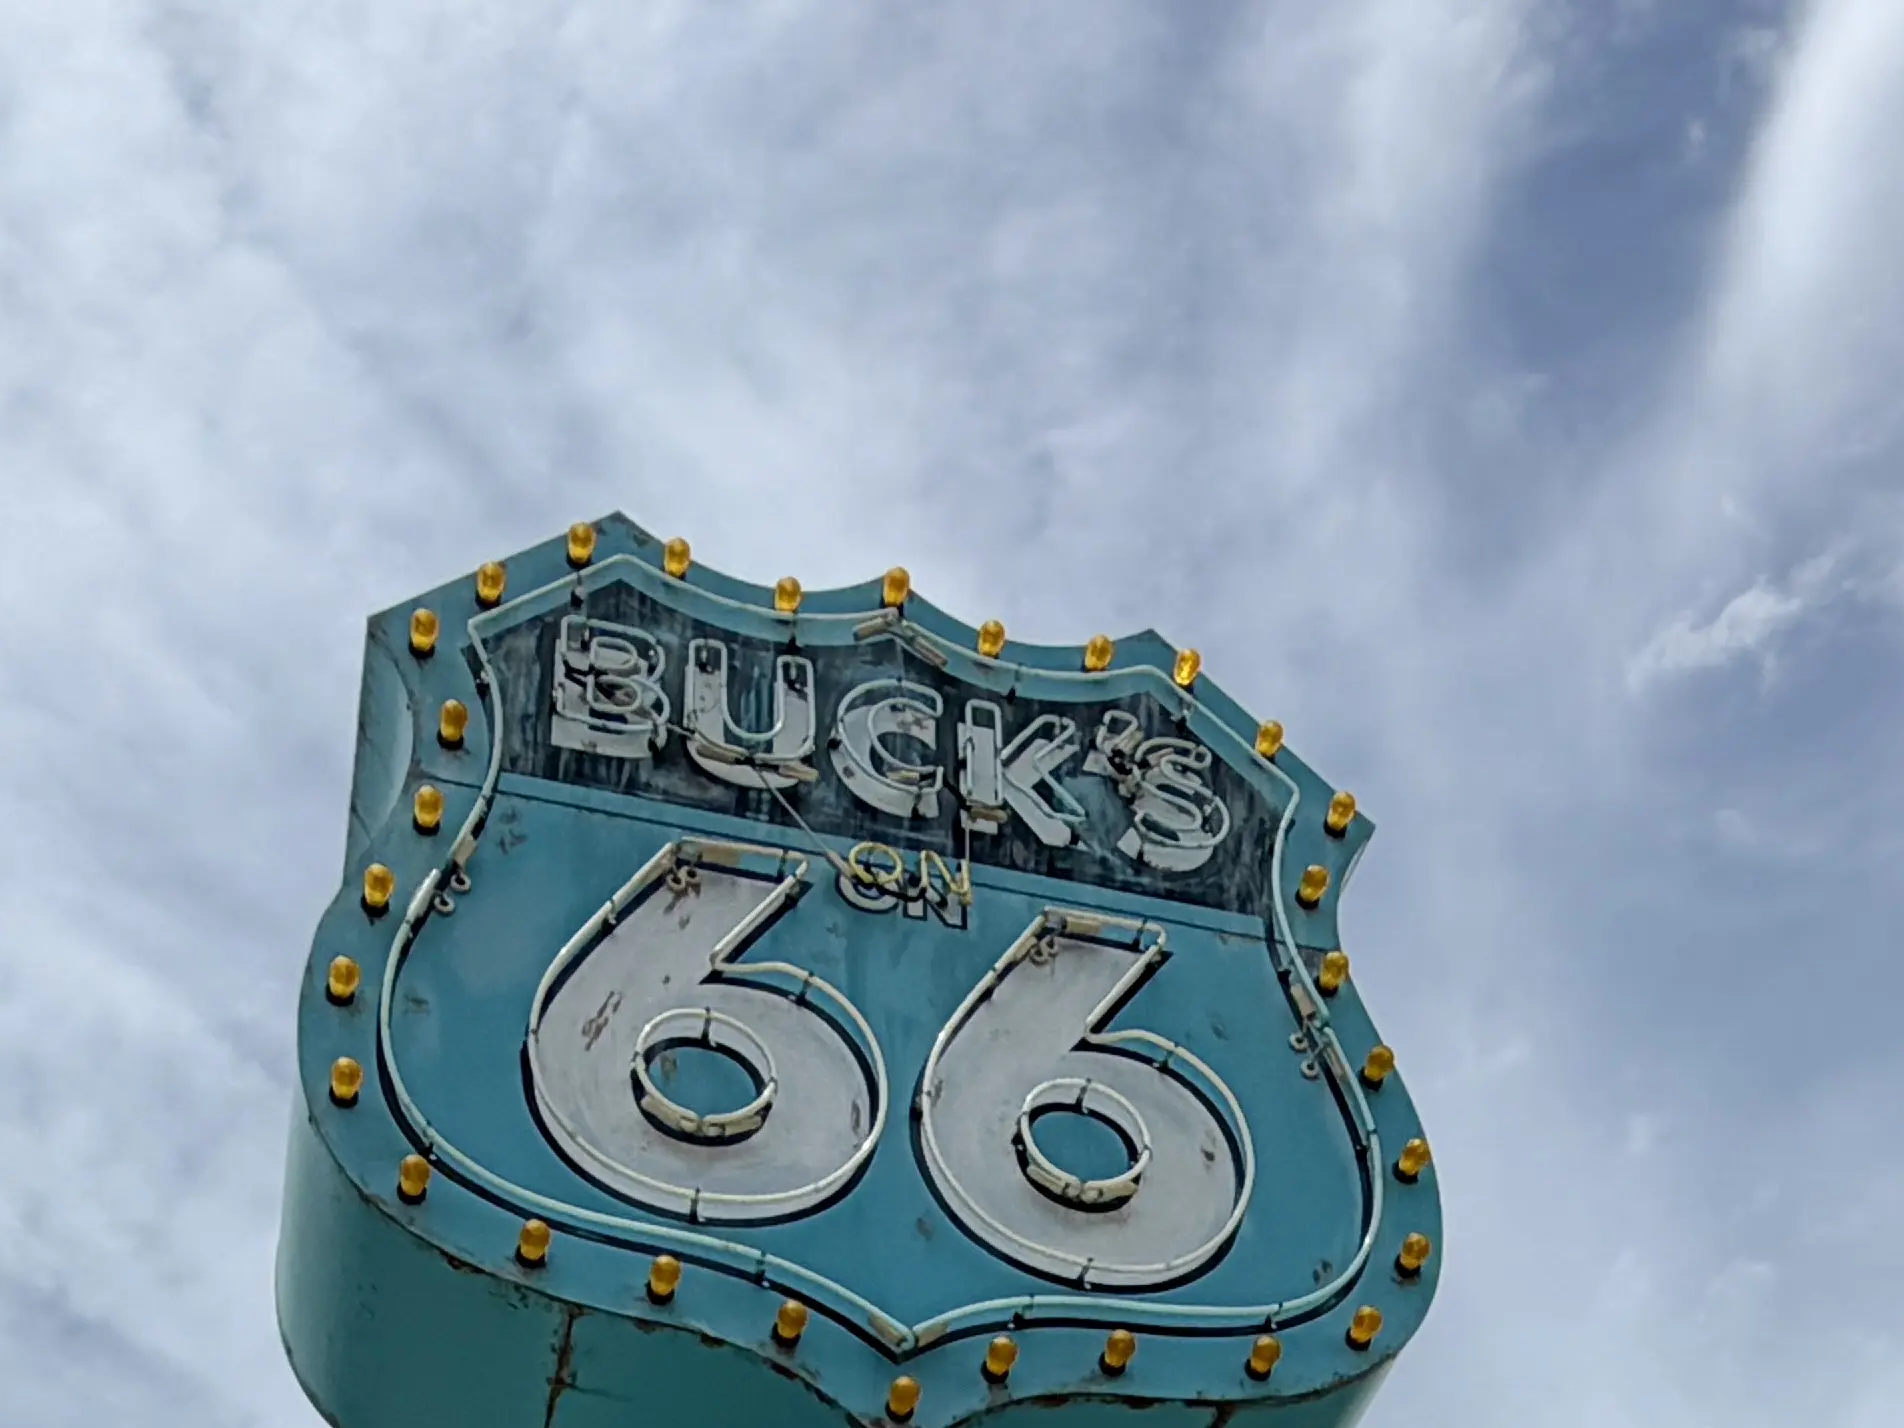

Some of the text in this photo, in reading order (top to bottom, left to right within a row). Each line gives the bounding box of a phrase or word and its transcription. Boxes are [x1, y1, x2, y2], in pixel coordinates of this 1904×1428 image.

[549, 613, 1230, 872] BUCK'S
[836, 840, 972, 927] ON
[519, 837, 1256, 1292] 66
